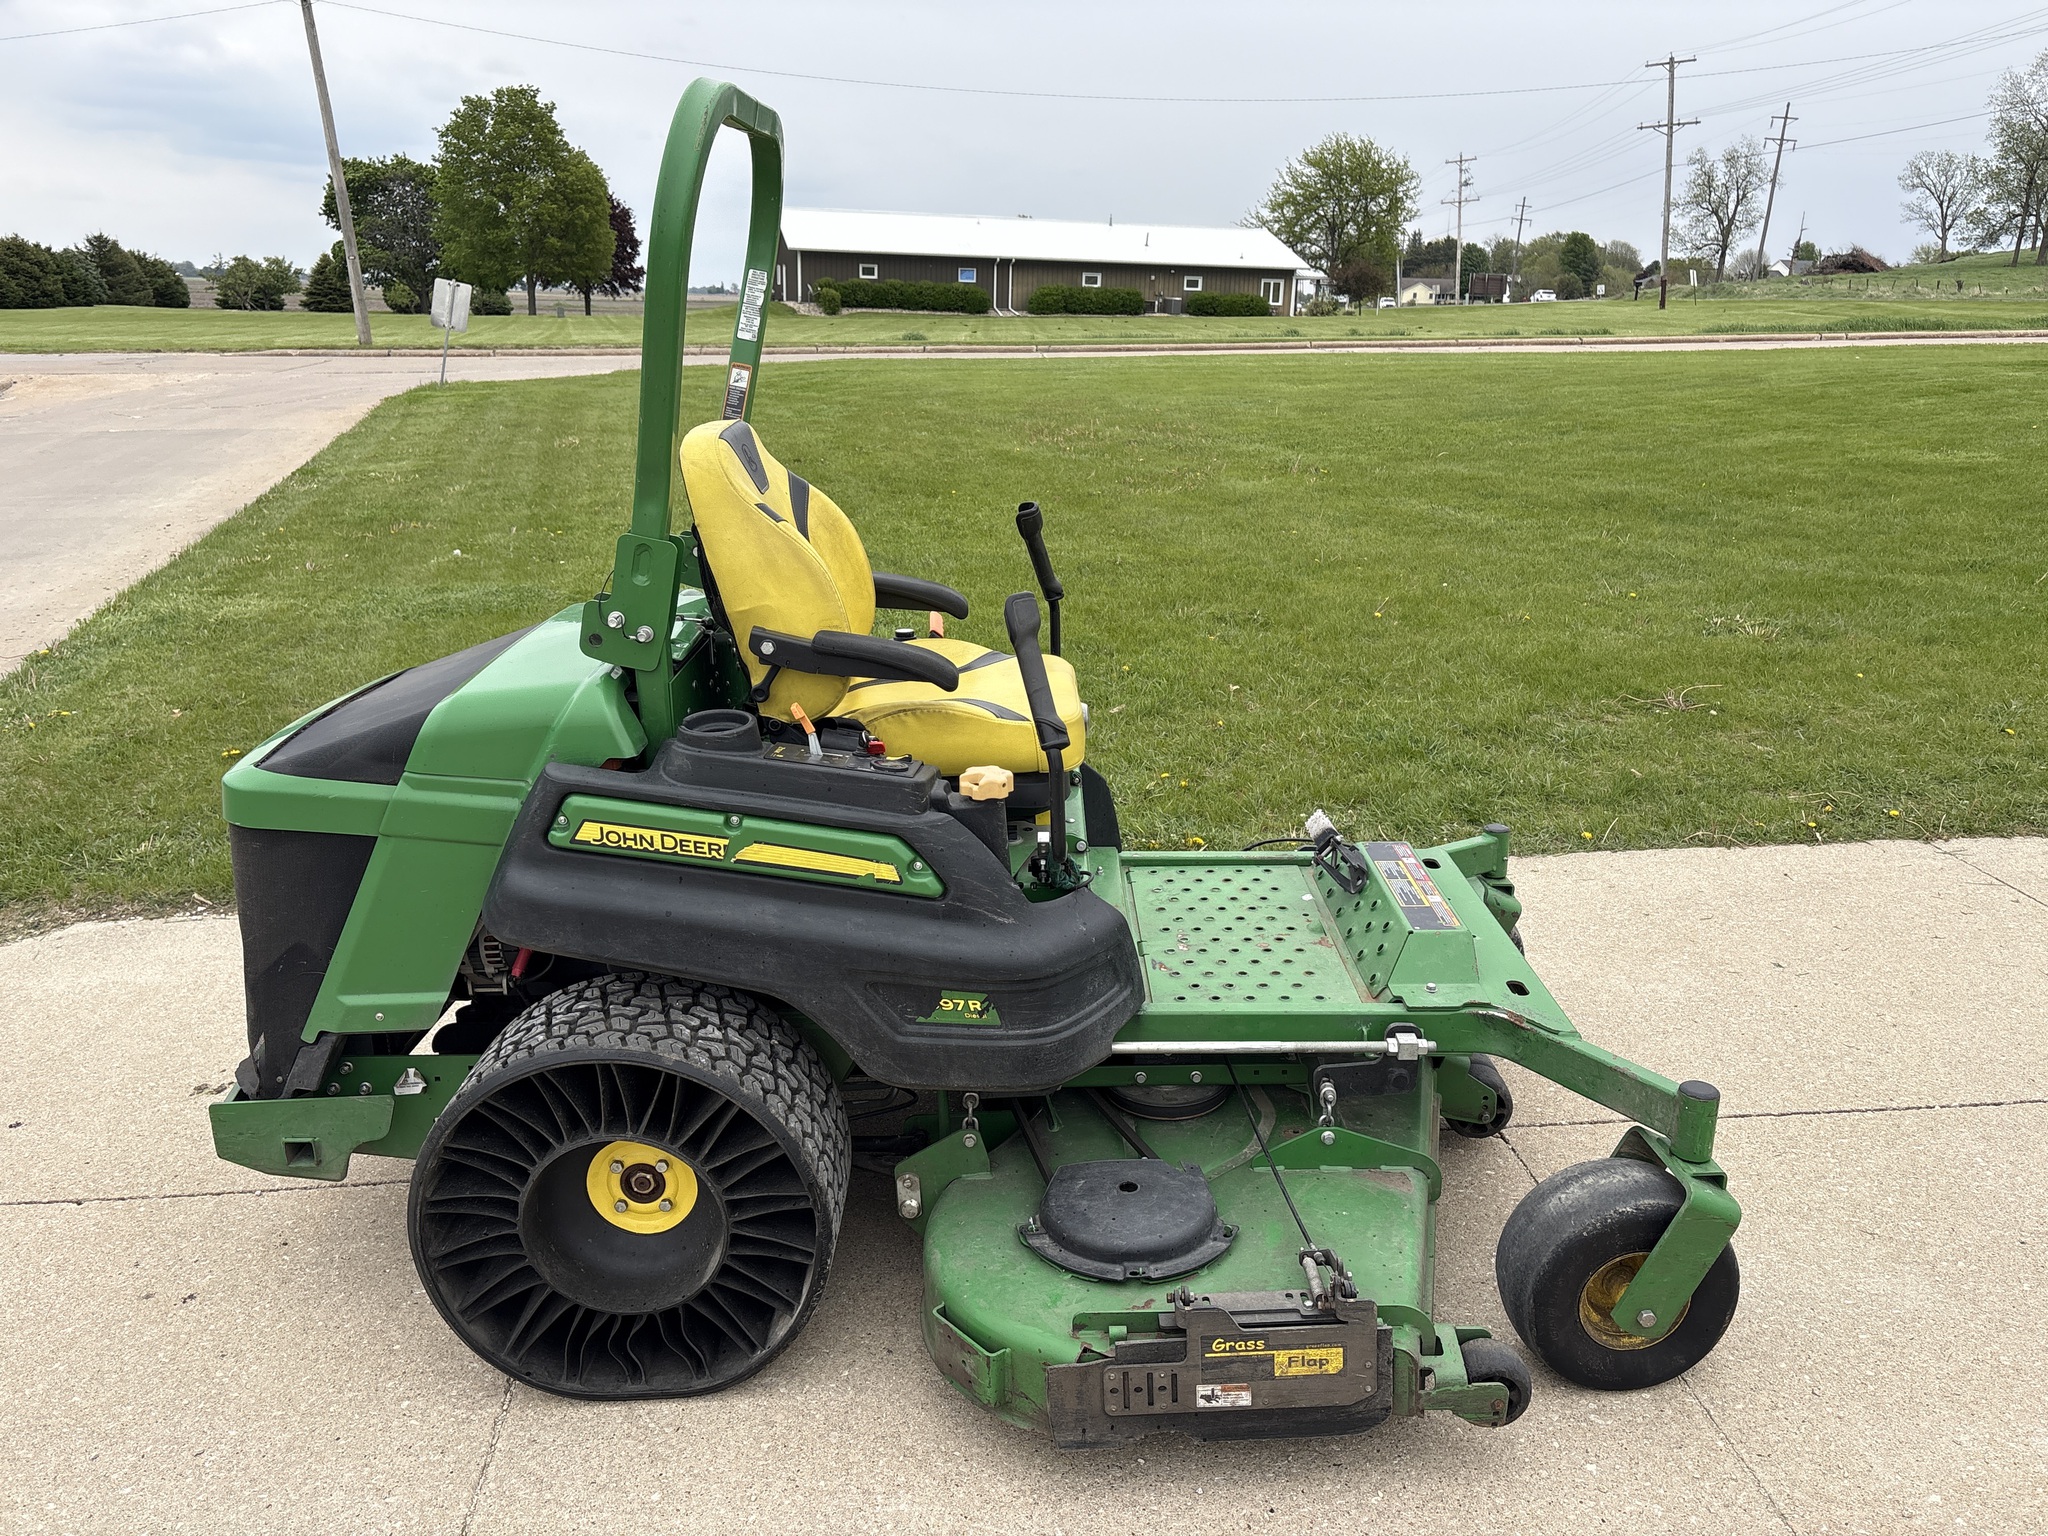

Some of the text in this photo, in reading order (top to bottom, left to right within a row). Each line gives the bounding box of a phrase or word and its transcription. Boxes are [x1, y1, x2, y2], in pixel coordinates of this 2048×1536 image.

[593, 826, 728, 858] JOHN DEER
[937, 999, 982, 1011] 97R
[1211, 1338, 1265, 1351] Grass
[1287, 1355, 1330, 1369] Flap
